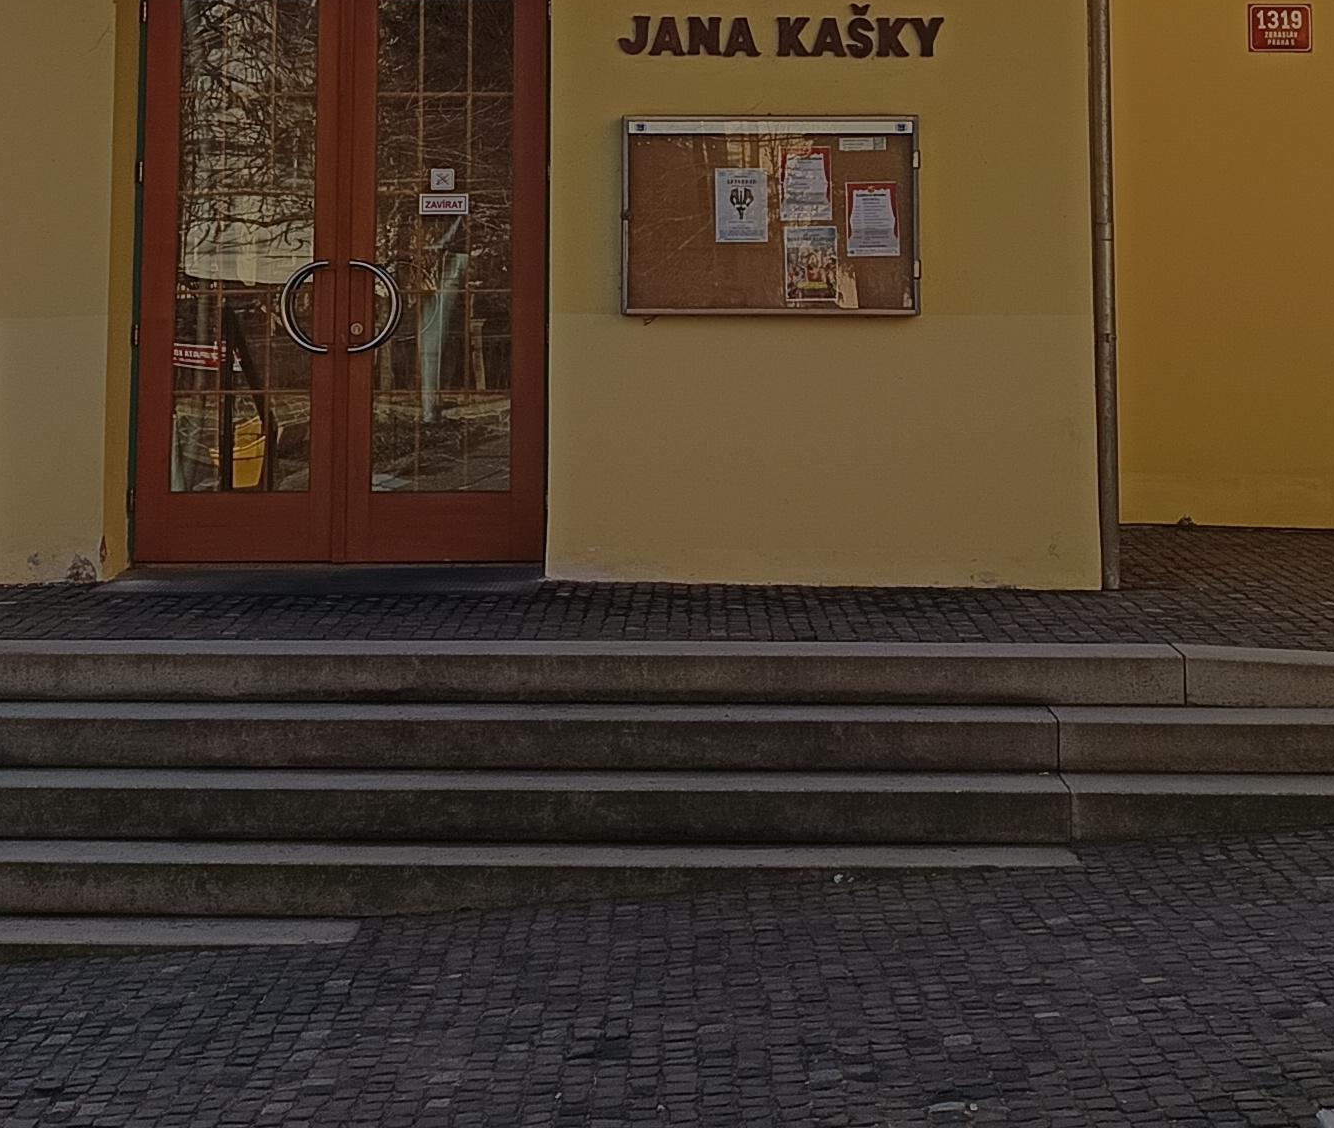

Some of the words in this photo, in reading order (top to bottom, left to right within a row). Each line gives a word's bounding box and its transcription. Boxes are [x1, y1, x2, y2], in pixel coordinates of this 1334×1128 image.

[1257, 10, 1302, 29] 1319
[618, 15, 762, 57] JANA
[776, 3, 945, 59] KAŠKY
[425, 199, 463, 209] ZAVÍRAT
